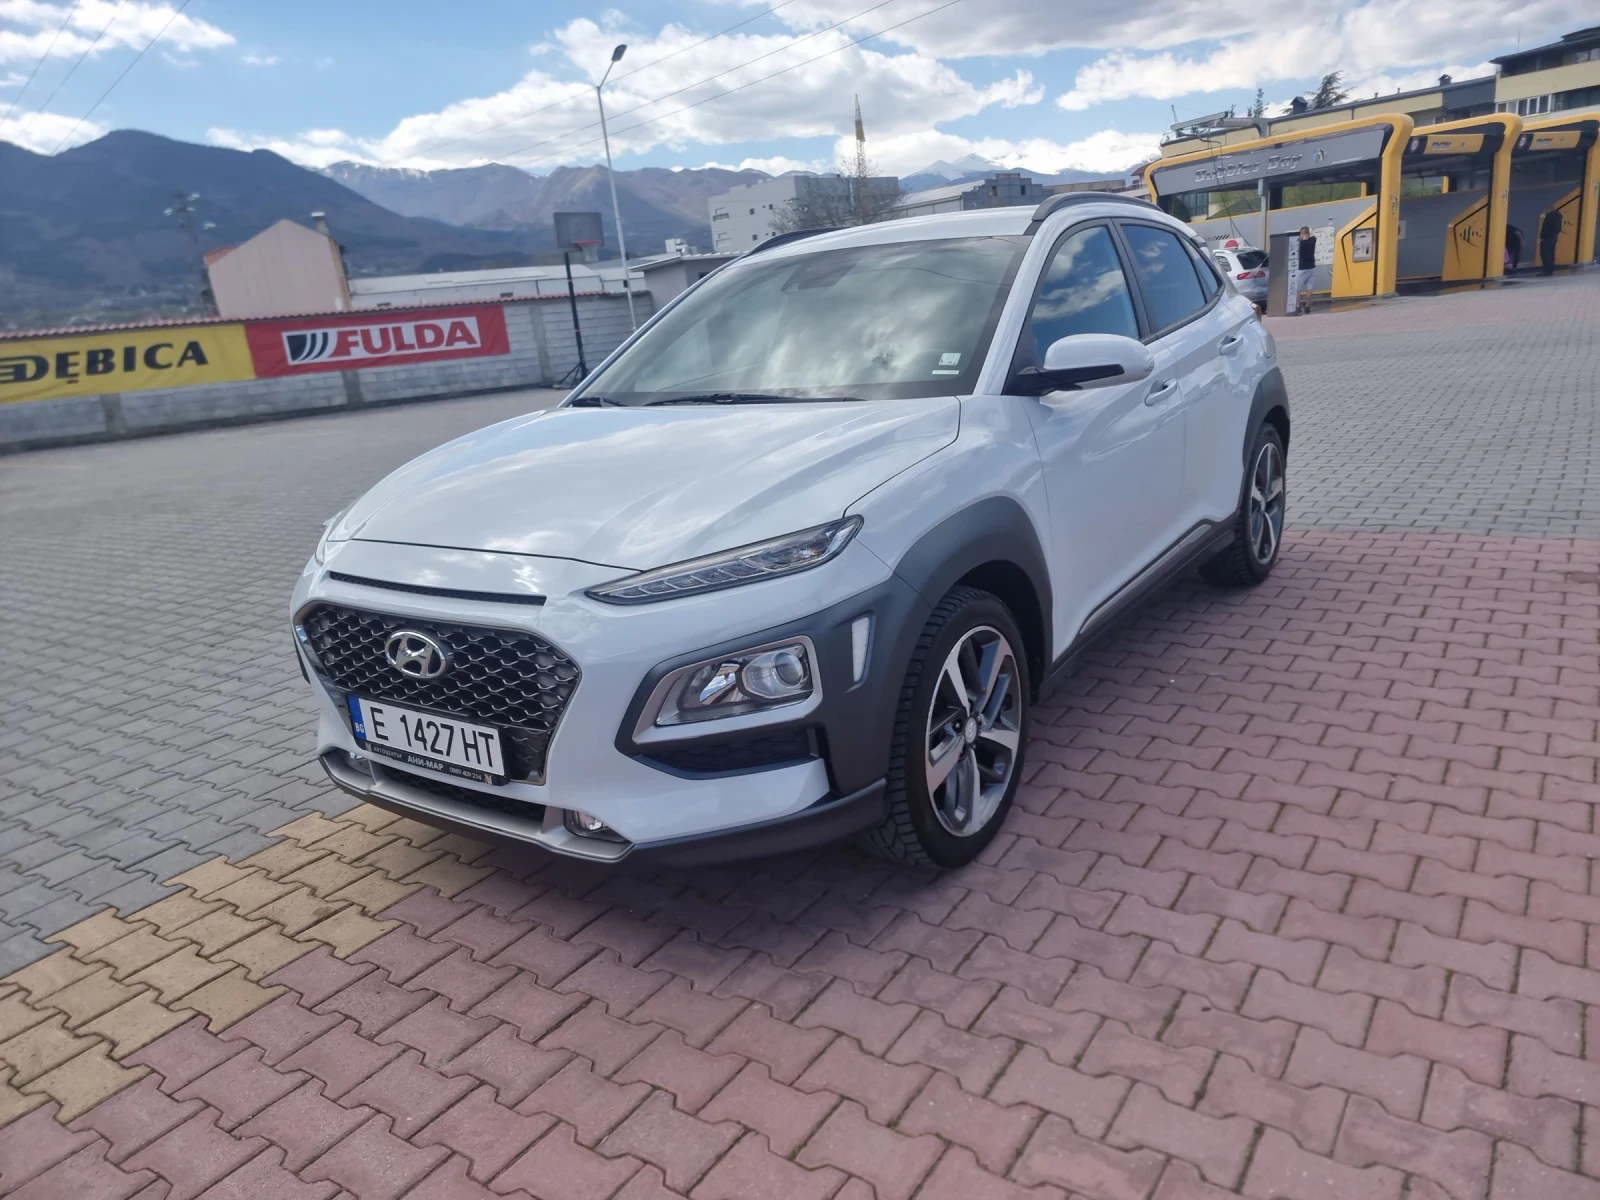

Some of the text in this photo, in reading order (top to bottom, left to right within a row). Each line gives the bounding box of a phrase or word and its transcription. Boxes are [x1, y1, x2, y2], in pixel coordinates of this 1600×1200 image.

[1194, 153, 1304, 183] Bubbles Bay
[328, 320, 478, 358] FULDA
[354, 722, 365, 733] BG
[370, 706, 495, 768] E 1427 HT
[407, 755, 444, 771] АНИ-МАР
